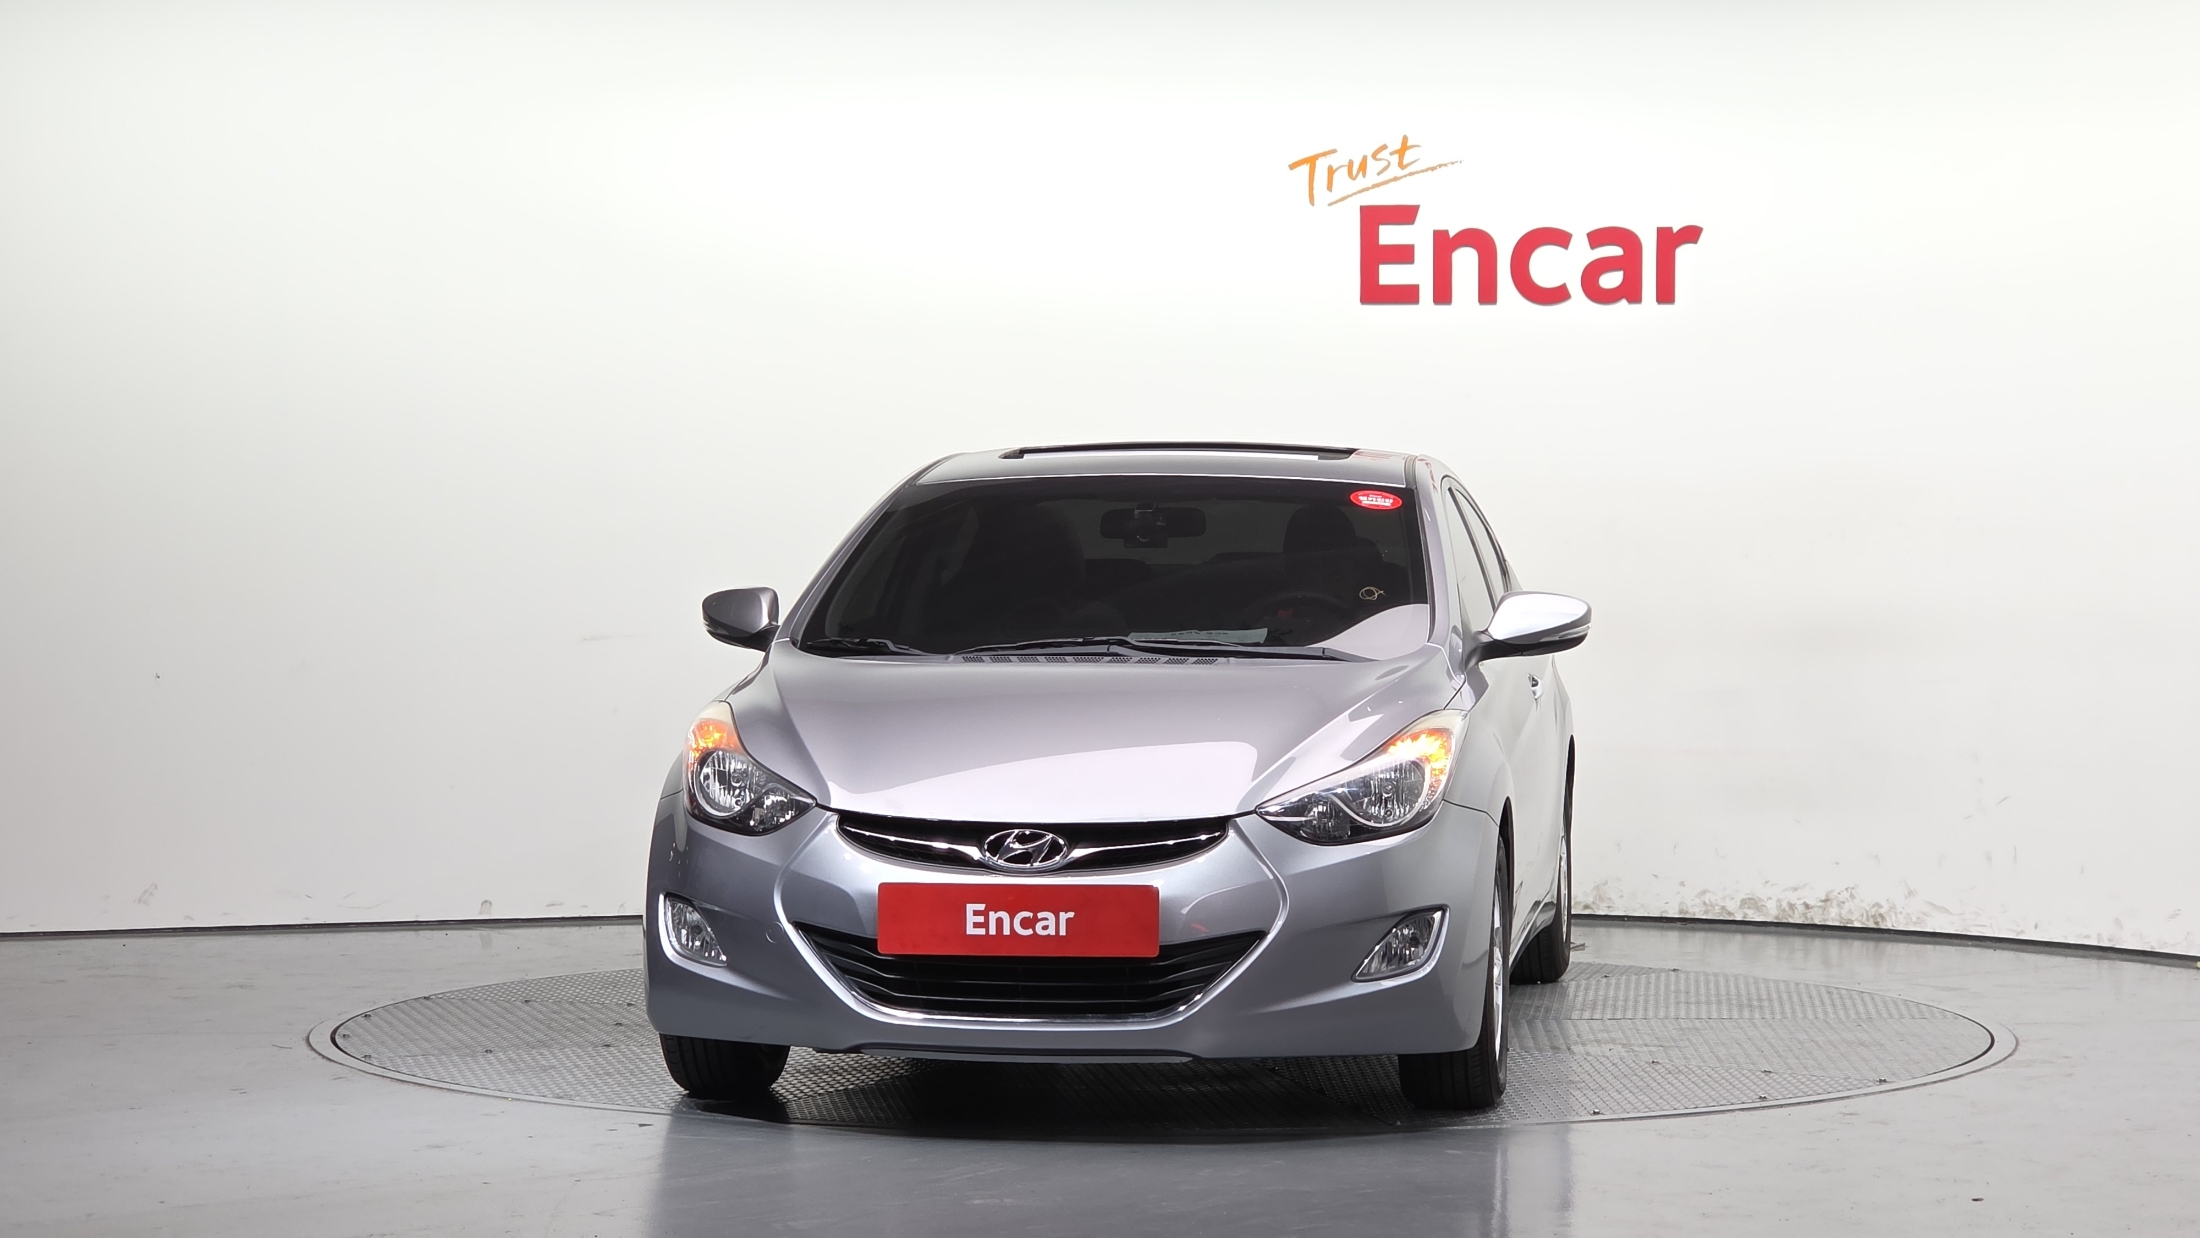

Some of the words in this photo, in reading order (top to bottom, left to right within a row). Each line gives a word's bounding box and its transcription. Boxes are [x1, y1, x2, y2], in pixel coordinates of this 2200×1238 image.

[1288, 134, 1421, 206] Trust
[1360, 204, 1703, 305] Encar
[965, 903, 1075, 936] Encar
